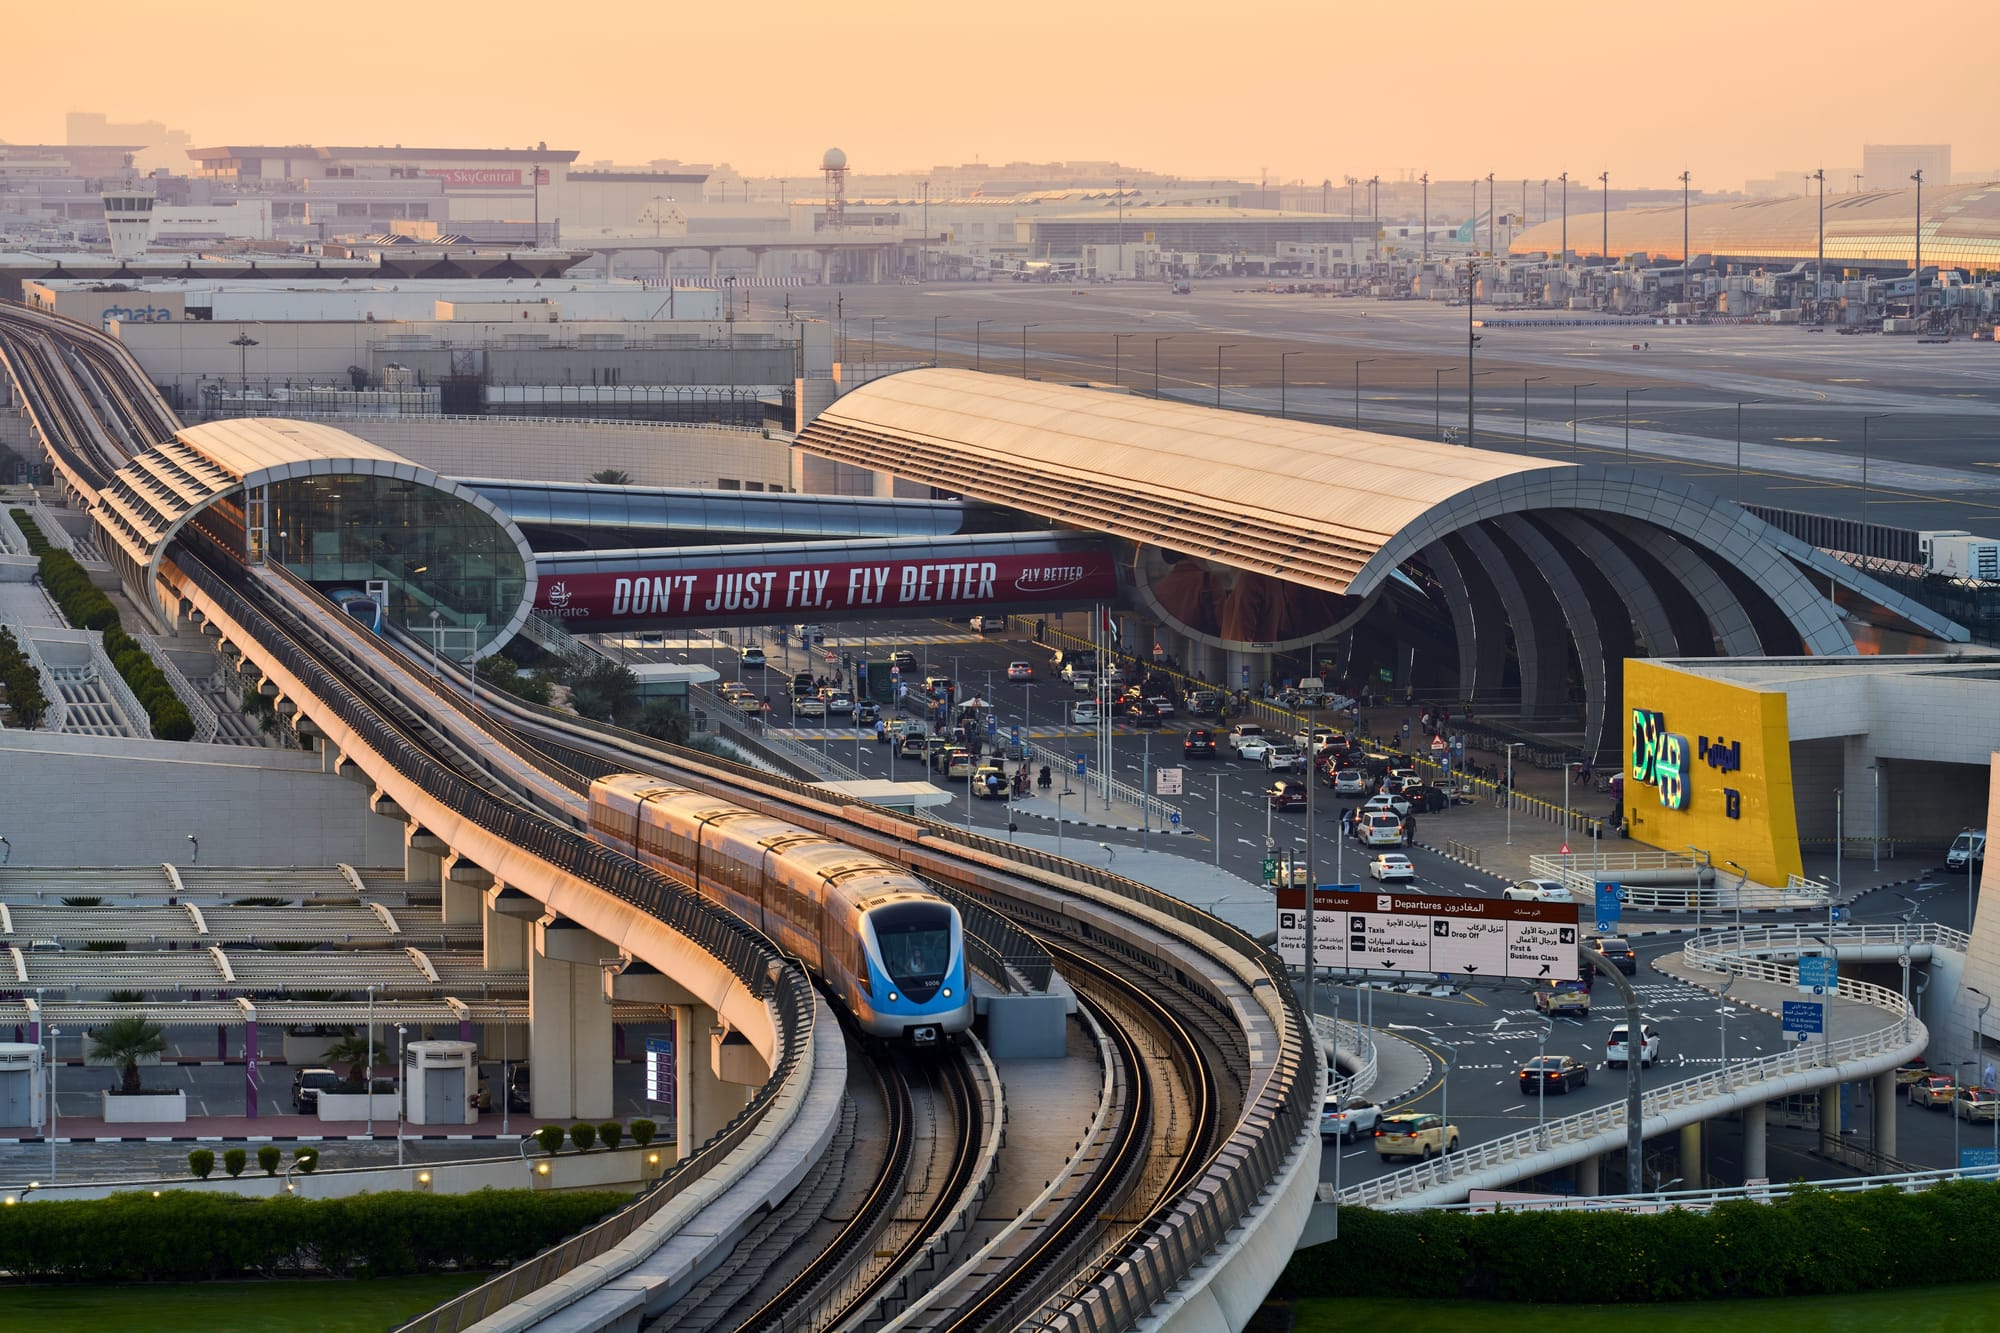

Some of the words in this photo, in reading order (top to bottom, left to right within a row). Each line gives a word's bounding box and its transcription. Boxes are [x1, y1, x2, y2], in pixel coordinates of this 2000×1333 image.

[454, 171, 515, 184] SkyCentral
[1021, 568, 1040, 582] FLY
[1042, 566, 1083, 581] BETTER
[612, 575, 697, 615] DON'T
[705, 571, 777, 611] JUST
[785, 569, 832, 609] FLY,
[846, 566, 890, 605] FLY
[898, 562, 996, 602] BETTER
[531, 606, 590, 617] Emirates
[1395, 901, 1441, 910] Departures
[1445, 903, 1484, 912] المغادرون
